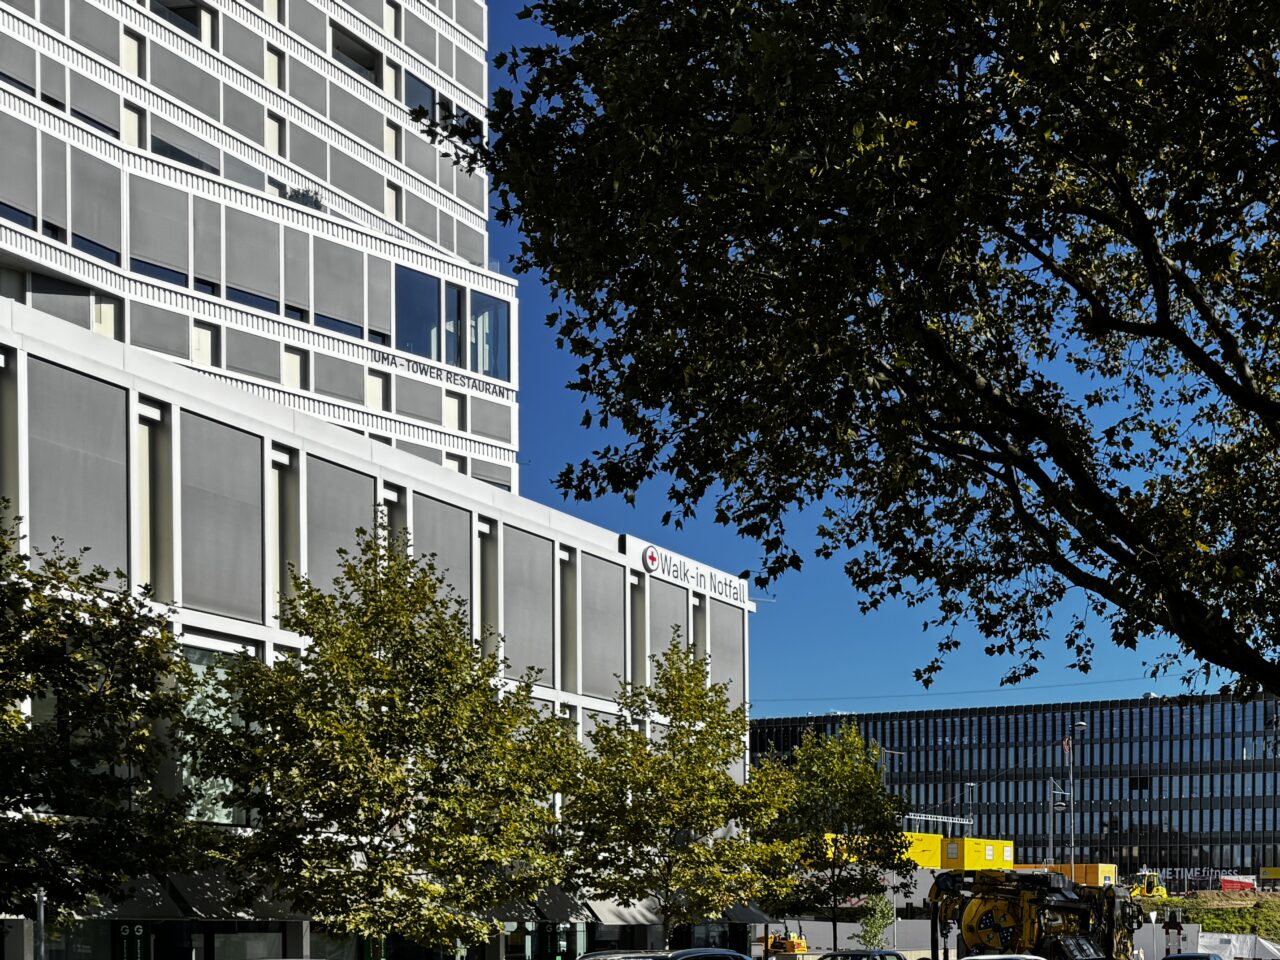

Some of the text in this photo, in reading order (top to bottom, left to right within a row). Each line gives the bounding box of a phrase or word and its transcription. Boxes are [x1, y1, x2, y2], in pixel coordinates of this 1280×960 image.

[446, 371, 511, 401] RESTAURANT
[660, 552, 746, 604] Walk-in Notfall
[1173, 867, 1200, 880] TIME
[1202, 866, 1238, 879] fitness
